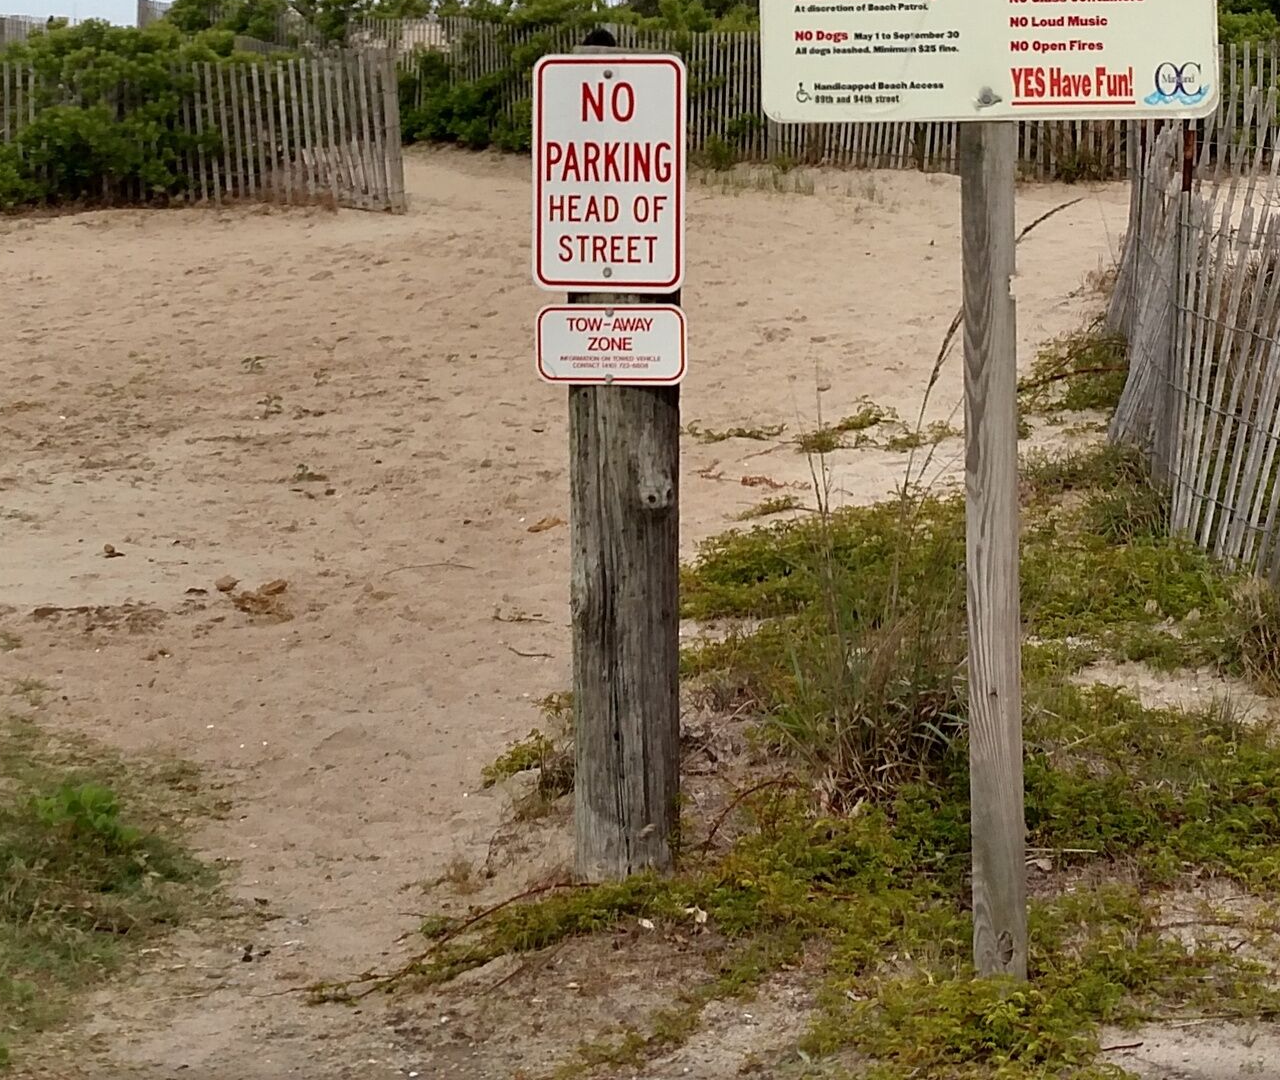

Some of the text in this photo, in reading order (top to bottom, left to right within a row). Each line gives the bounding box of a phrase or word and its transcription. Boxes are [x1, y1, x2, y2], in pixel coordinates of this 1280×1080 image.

[794, 2, 928, 13] At discretion of Beach Patrol.
[1010, 16, 1108, 27] NO Loud Music
[794, 31, 813, 41] NO
[816, 30, 848, 43] Dogs
[854, 32, 873, 42] May
[875, 32, 880, 40] 1
[882, 32, 891, 40] to
[947, 31, 960, 39] 30
[795, 46, 807, 55] All
[809, 46, 831, 56] dogs
[918, 44, 937, 53] $25
[939, 44, 960, 53] fine.
[1010, 40, 1104, 53] NO Open Fires
[1010, 66, 1134, 98] YES Have Fun!
[1154, 61, 1202, 97] OC
[814, 81, 944, 92] Handicapped Beach Access
[582, 82, 635, 122] NO
[836, 95, 851, 104] and
[875, 94, 900, 103] street
[546, 142, 672, 182] PARKING
[549, 195, 668, 223] HEAD OF
[558, 235, 658, 263] STREET
[566, 318, 653, 332] TOW-AWAY
[587, 337, 633, 351] ZONE
